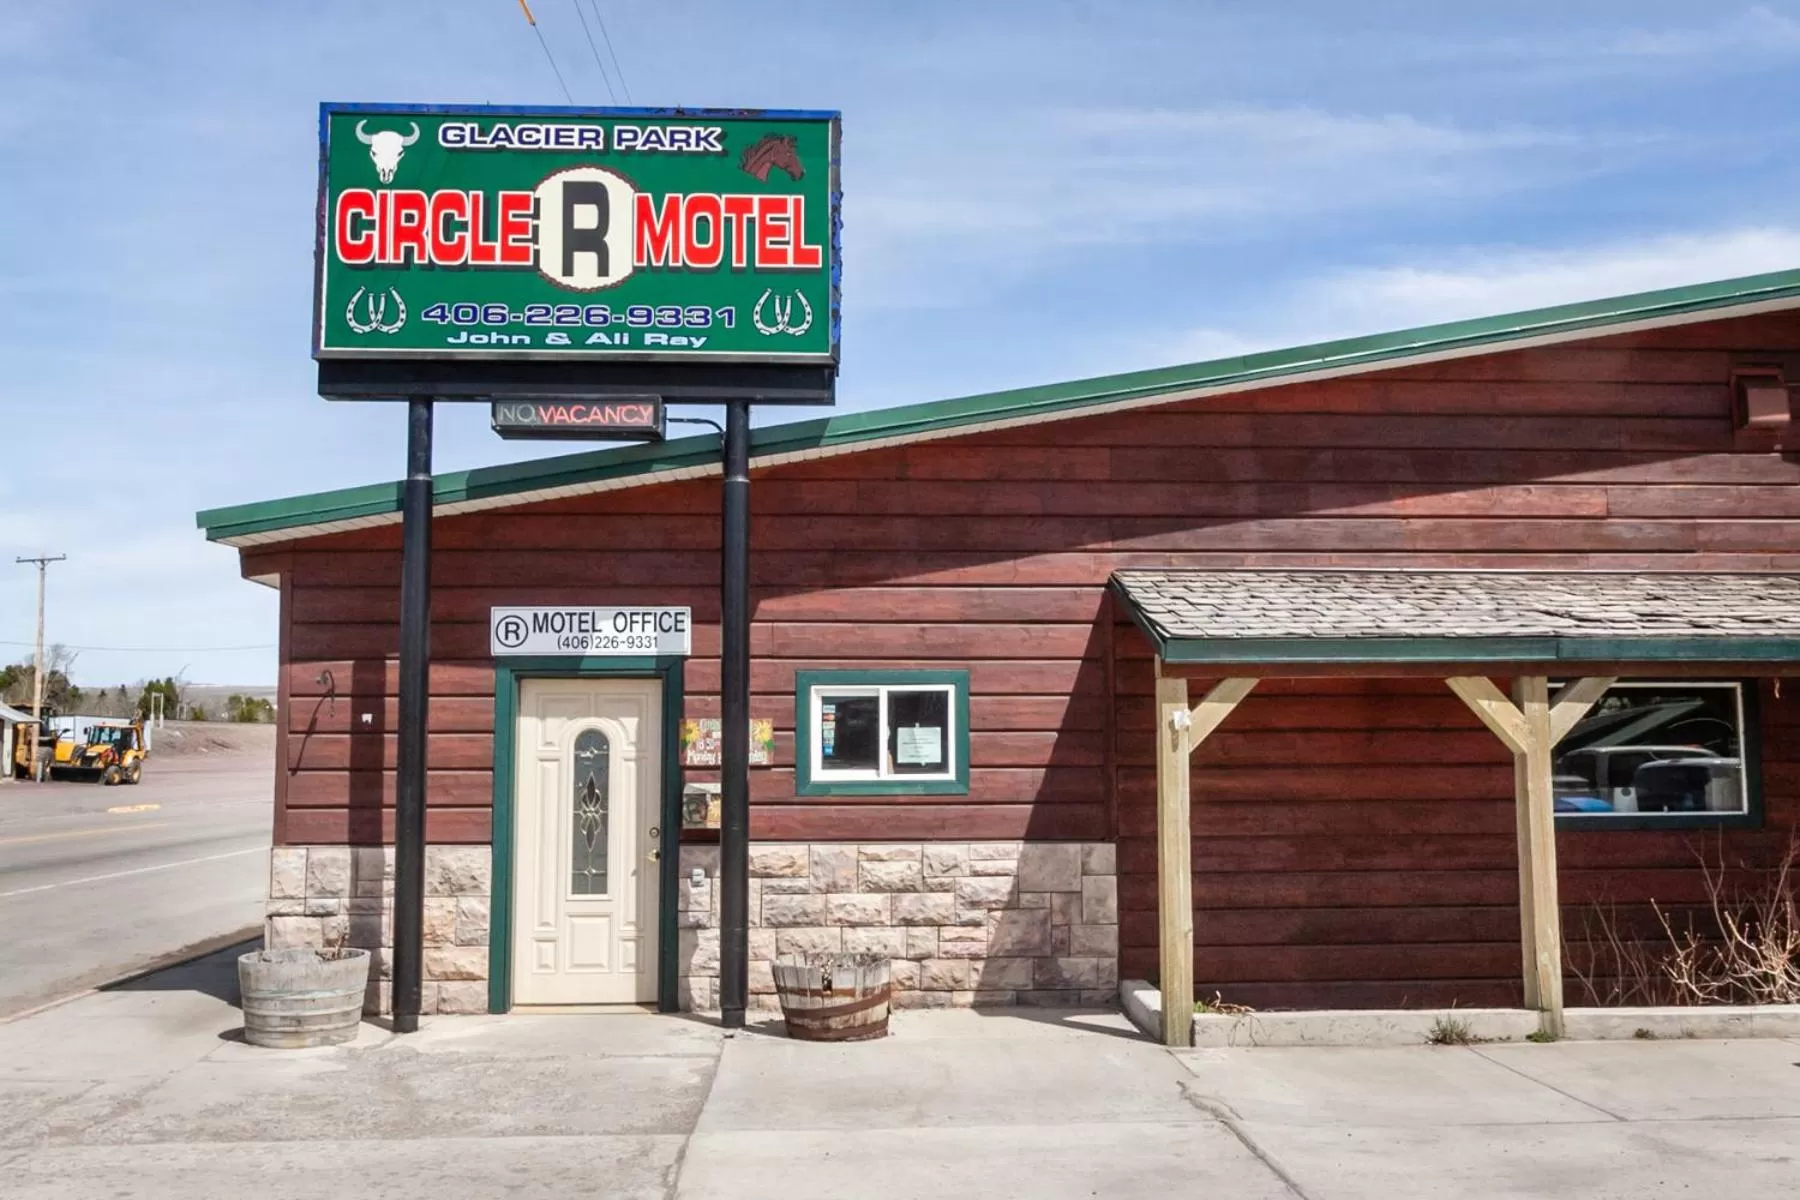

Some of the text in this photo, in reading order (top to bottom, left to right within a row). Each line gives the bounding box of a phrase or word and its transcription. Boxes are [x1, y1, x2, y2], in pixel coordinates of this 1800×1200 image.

[439, 122, 722, 151] GLACIER PARK
[336, 181, 822, 277] CIRCLE R MOTEL
[421, 303, 736, 328] 406-226-9331
[447, 331, 707, 348] John & Ali Ray
[500, 404, 654, 424] NO VACANCY
[504, 611, 686, 641] R MOTEL OFFICE
[557, 635, 659, 650] (406)226-9331
